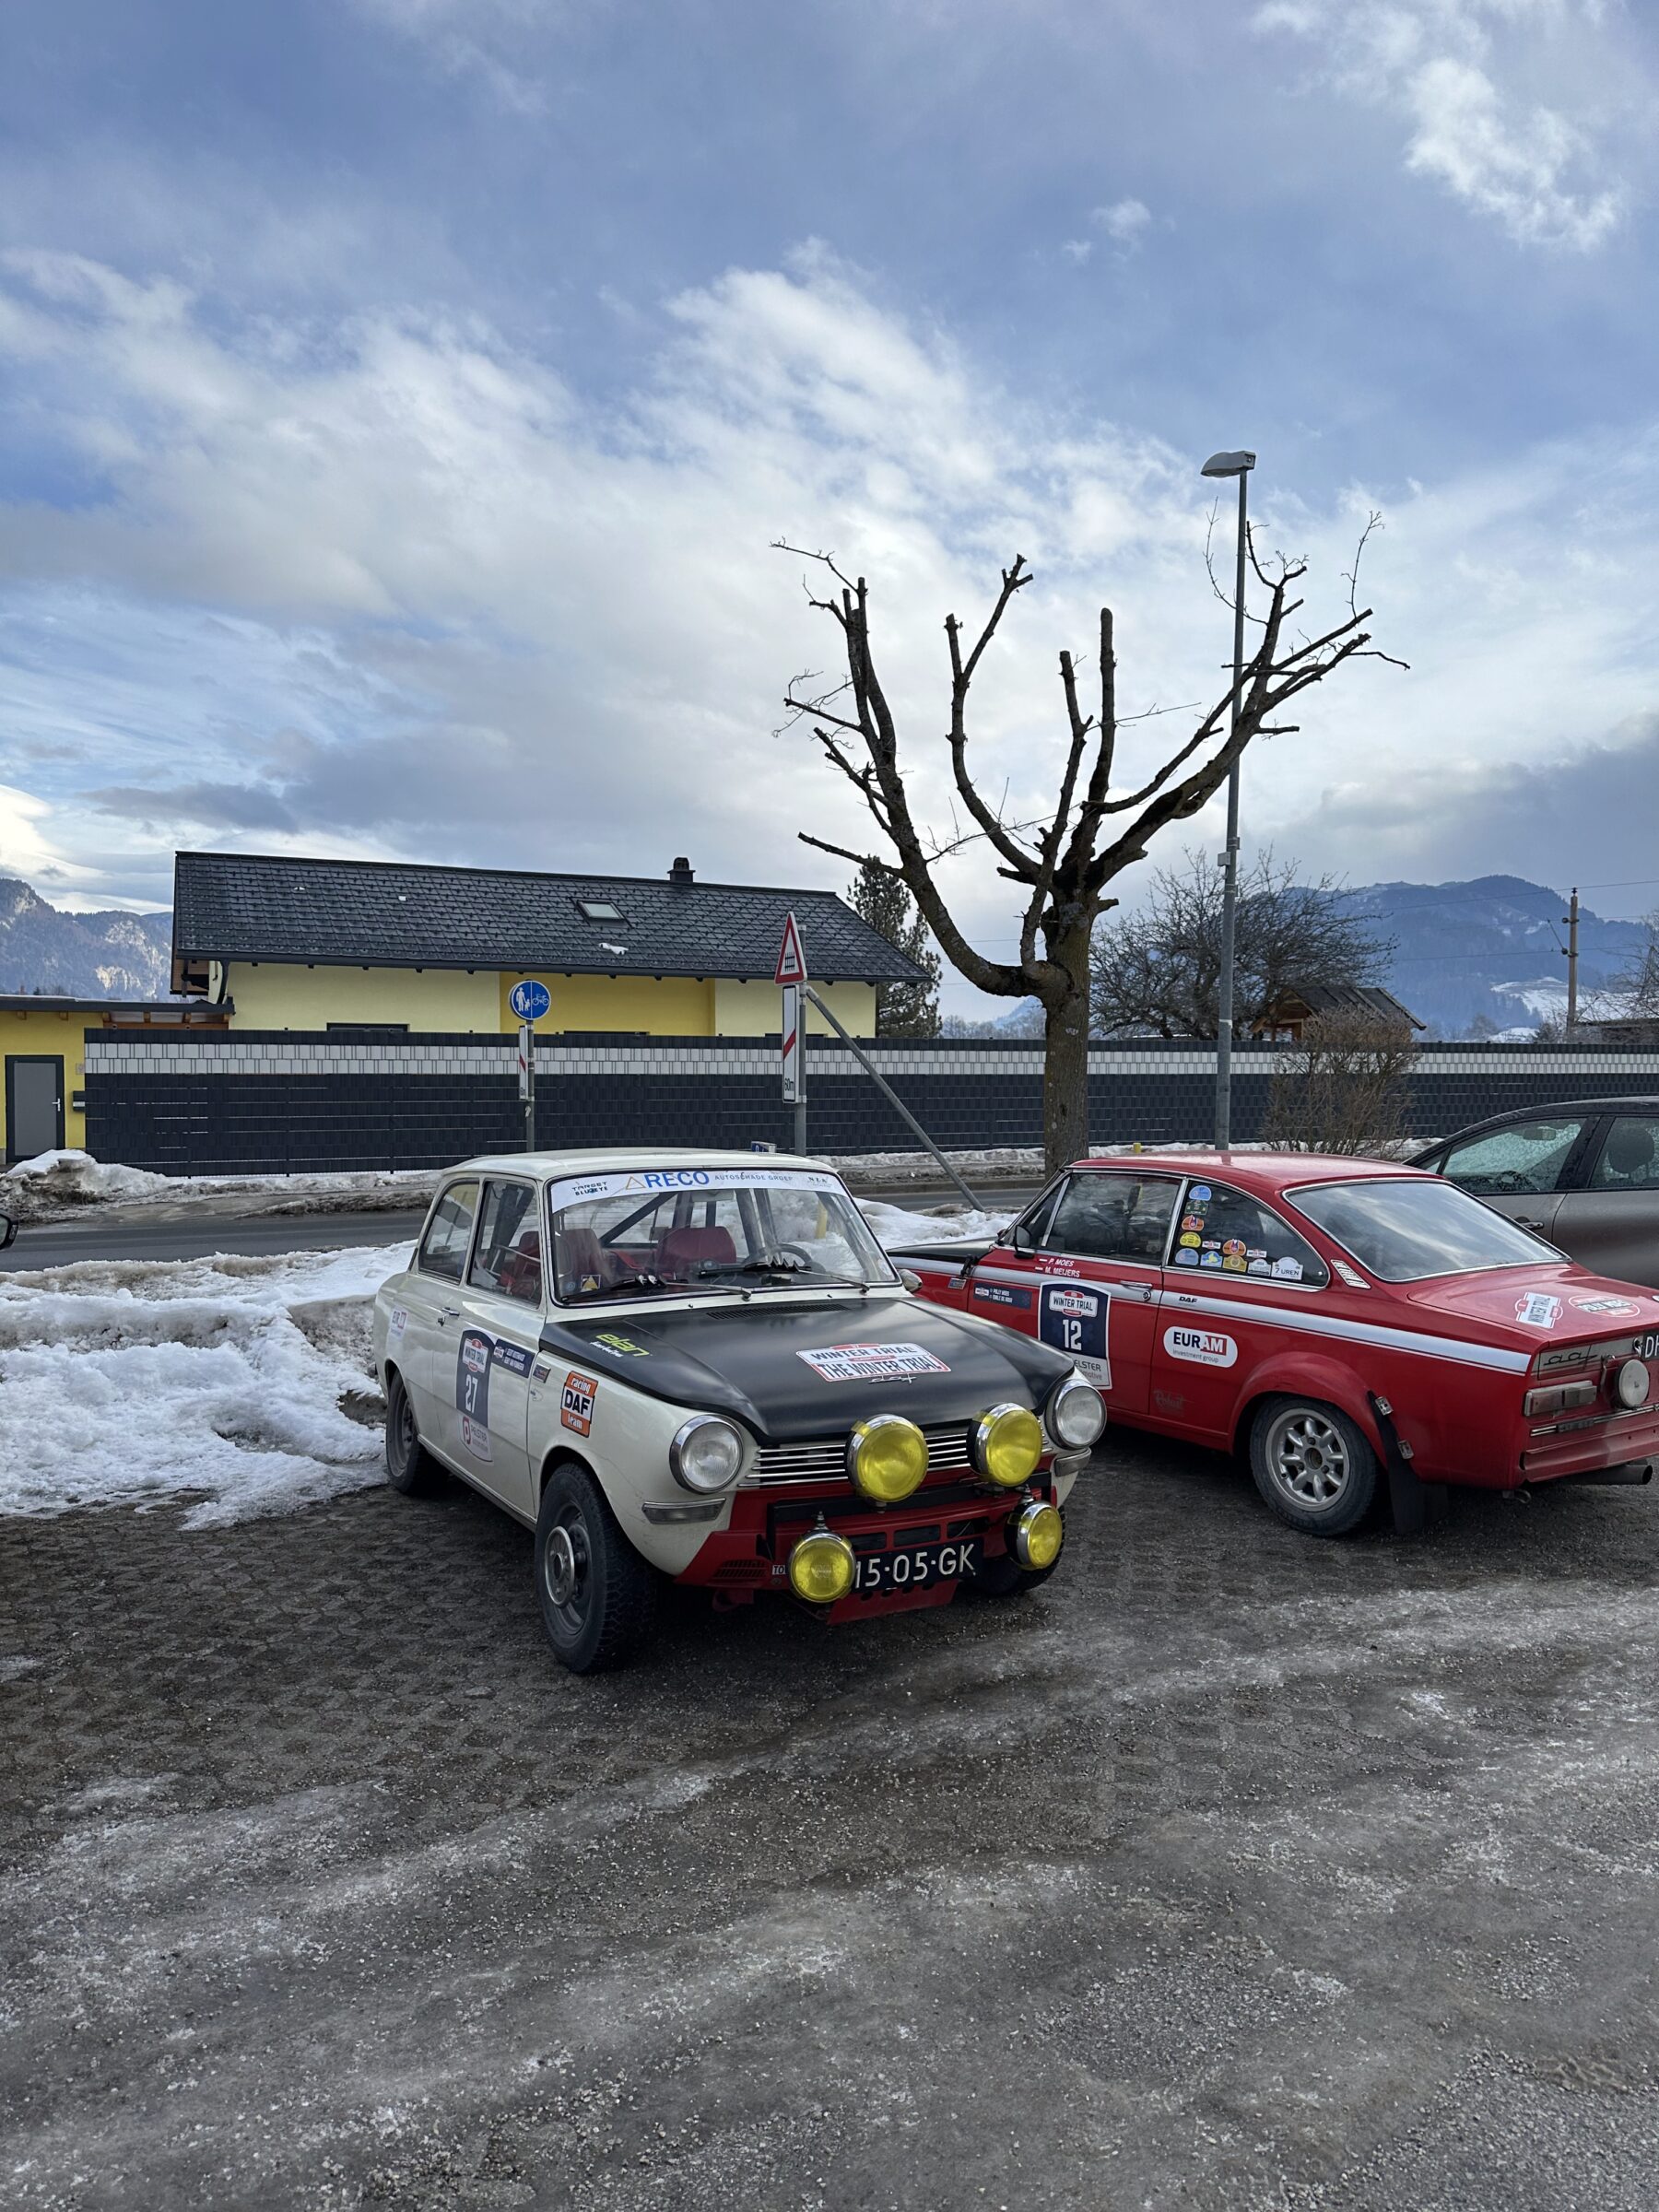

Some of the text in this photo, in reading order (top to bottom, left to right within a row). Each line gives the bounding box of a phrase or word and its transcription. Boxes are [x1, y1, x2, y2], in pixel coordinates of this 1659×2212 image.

[644, 1171, 710, 1188] RECO
[1055, 1259, 1075, 1267] MOES
[1053, 1296, 1093, 1311] WINTER TRIAL
[1062, 1319, 1082, 1351] 12
[1173, 1331, 1227, 1356] EURAM
[811, 1349, 868, 1360] WINTER
[875, 1346, 917, 1355] TRIAL
[1172, 1348, 1219, 1363] investment group
[818, 1356, 942, 1378] THE WINTER TRIAL
[1074, 1359, 1101, 1371] ELSTER
[465, 1373, 478, 1414] 27
[571, 1377, 591, 1394] racing
[564, 1389, 591, 1415] DAF
[568, 1413, 582, 1430] team
